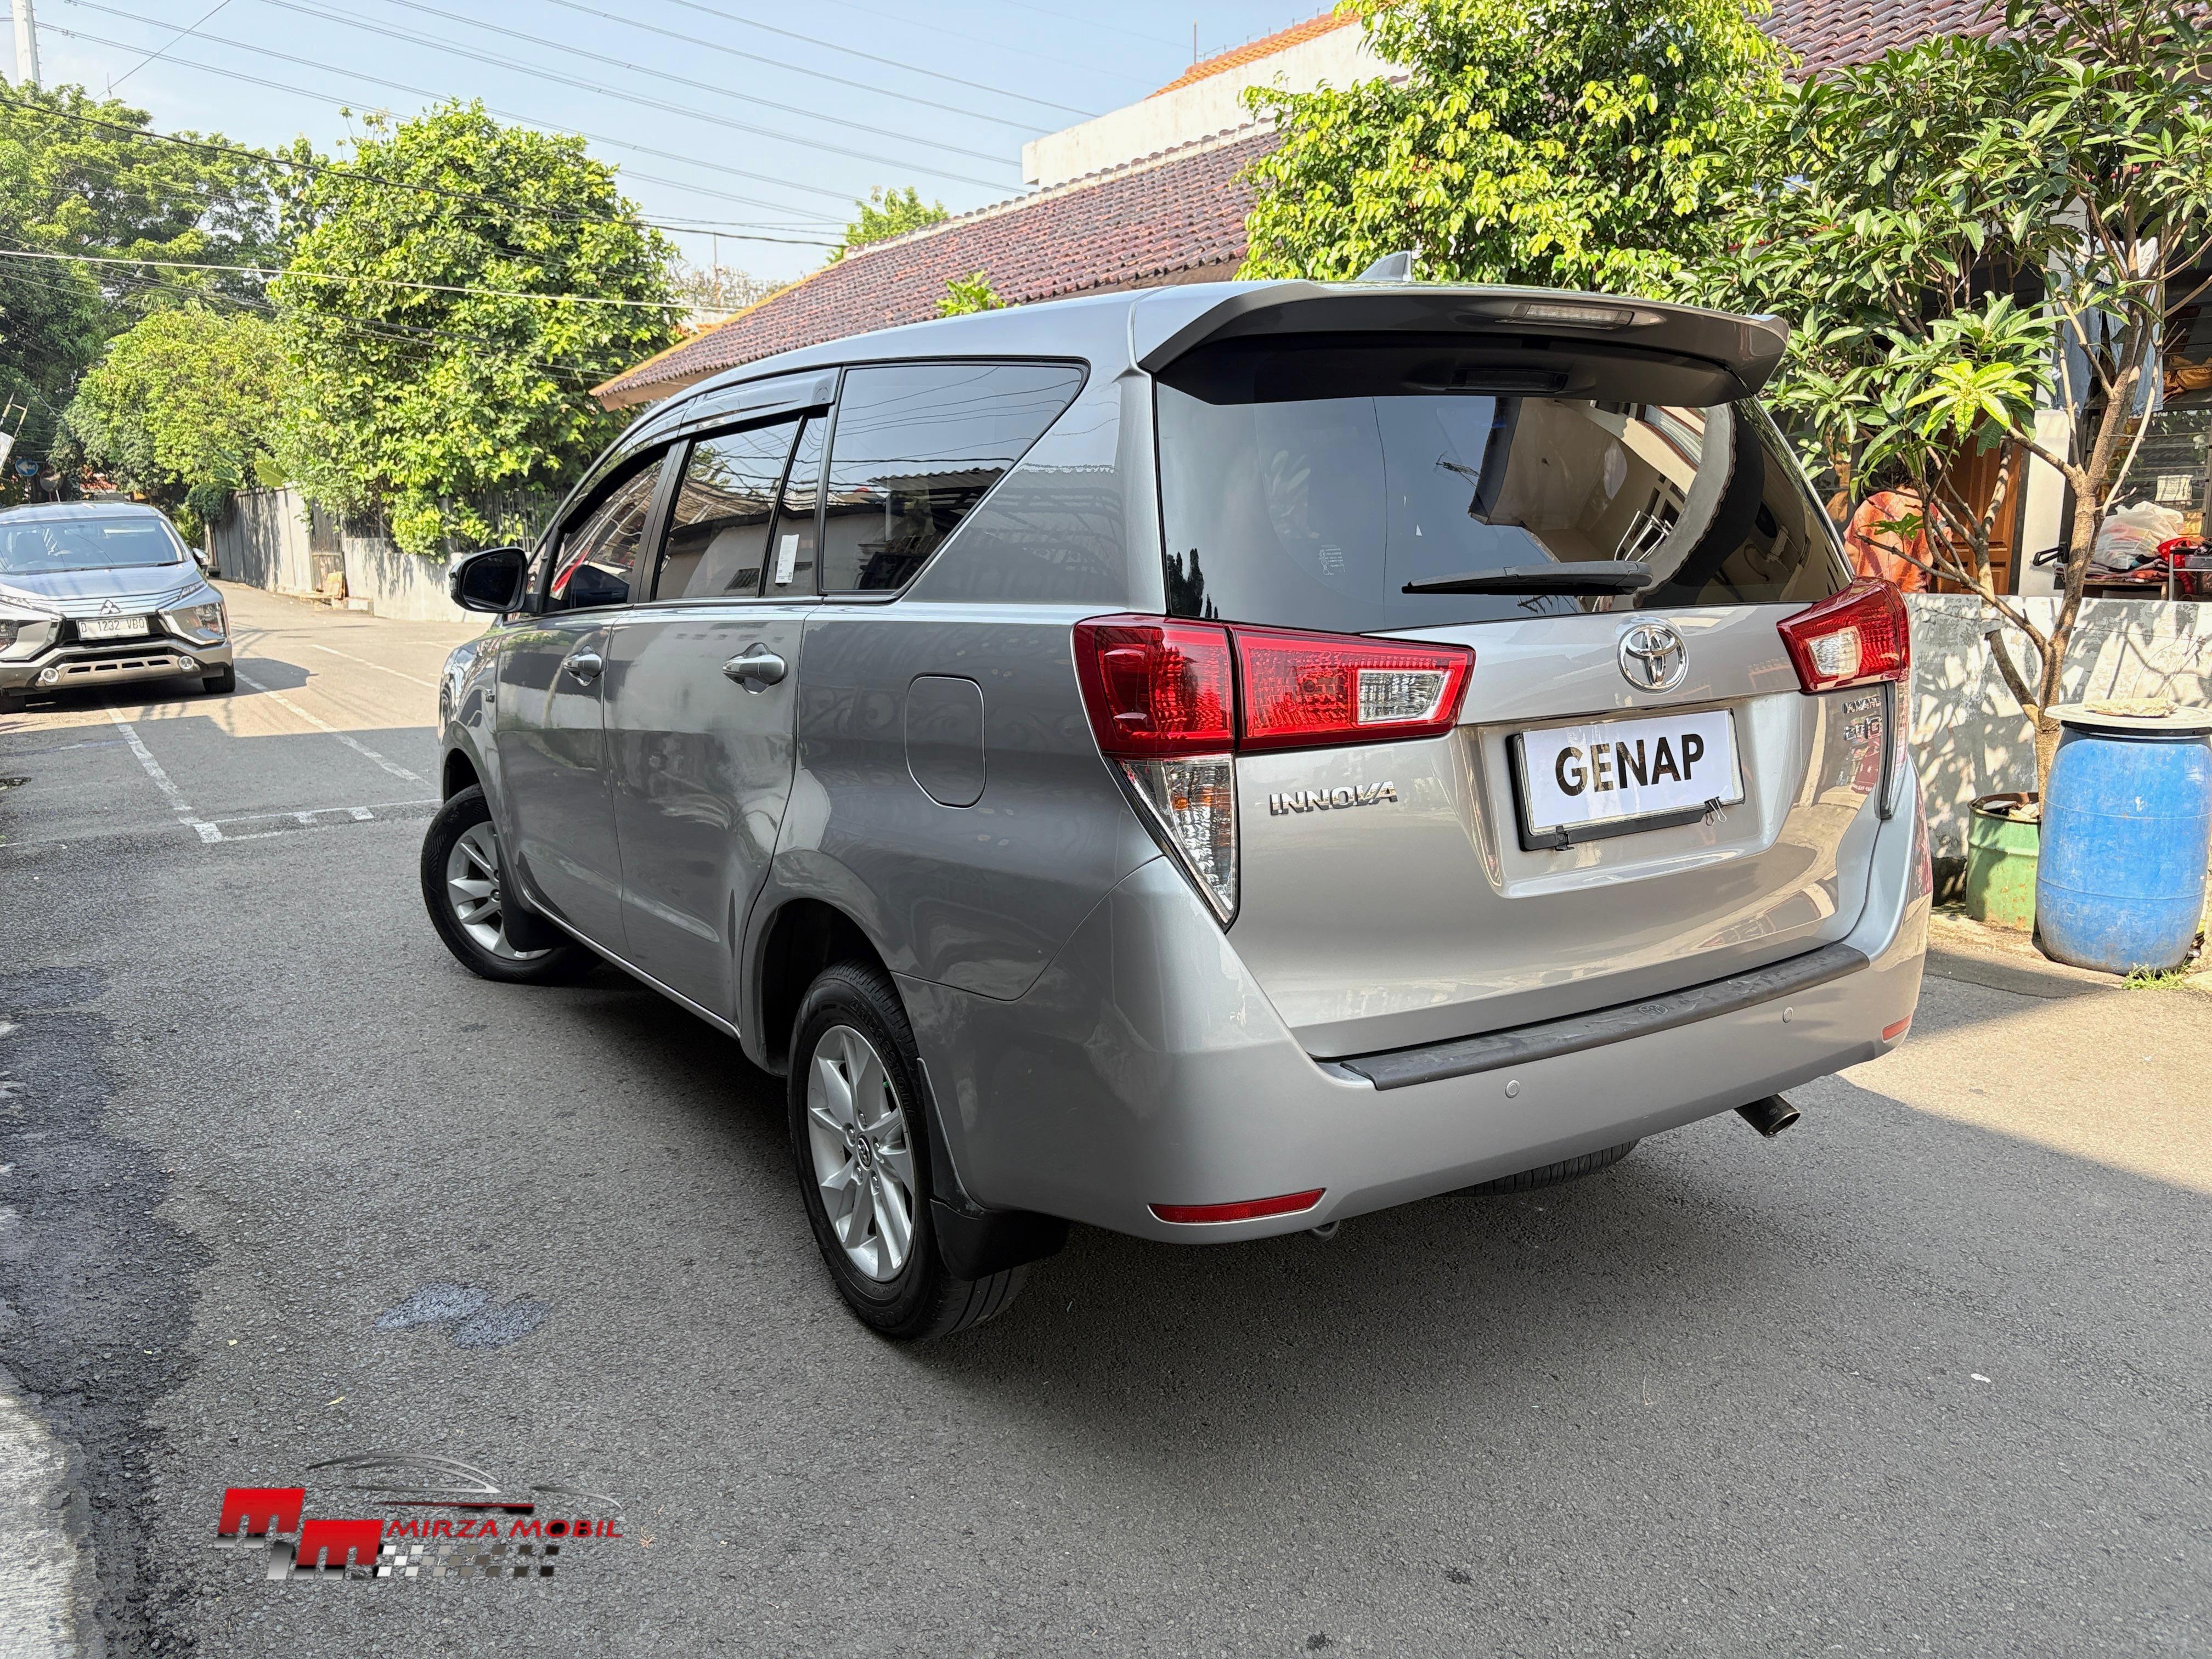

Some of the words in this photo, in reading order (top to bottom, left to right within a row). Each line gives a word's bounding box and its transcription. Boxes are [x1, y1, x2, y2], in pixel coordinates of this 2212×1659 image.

[81, 622, 87, 633] D
[97, 620, 120, 632] 1232
[1555, 733, 1704, 796] GENAP
[1269, 781, 1398, 816] INNOVA
